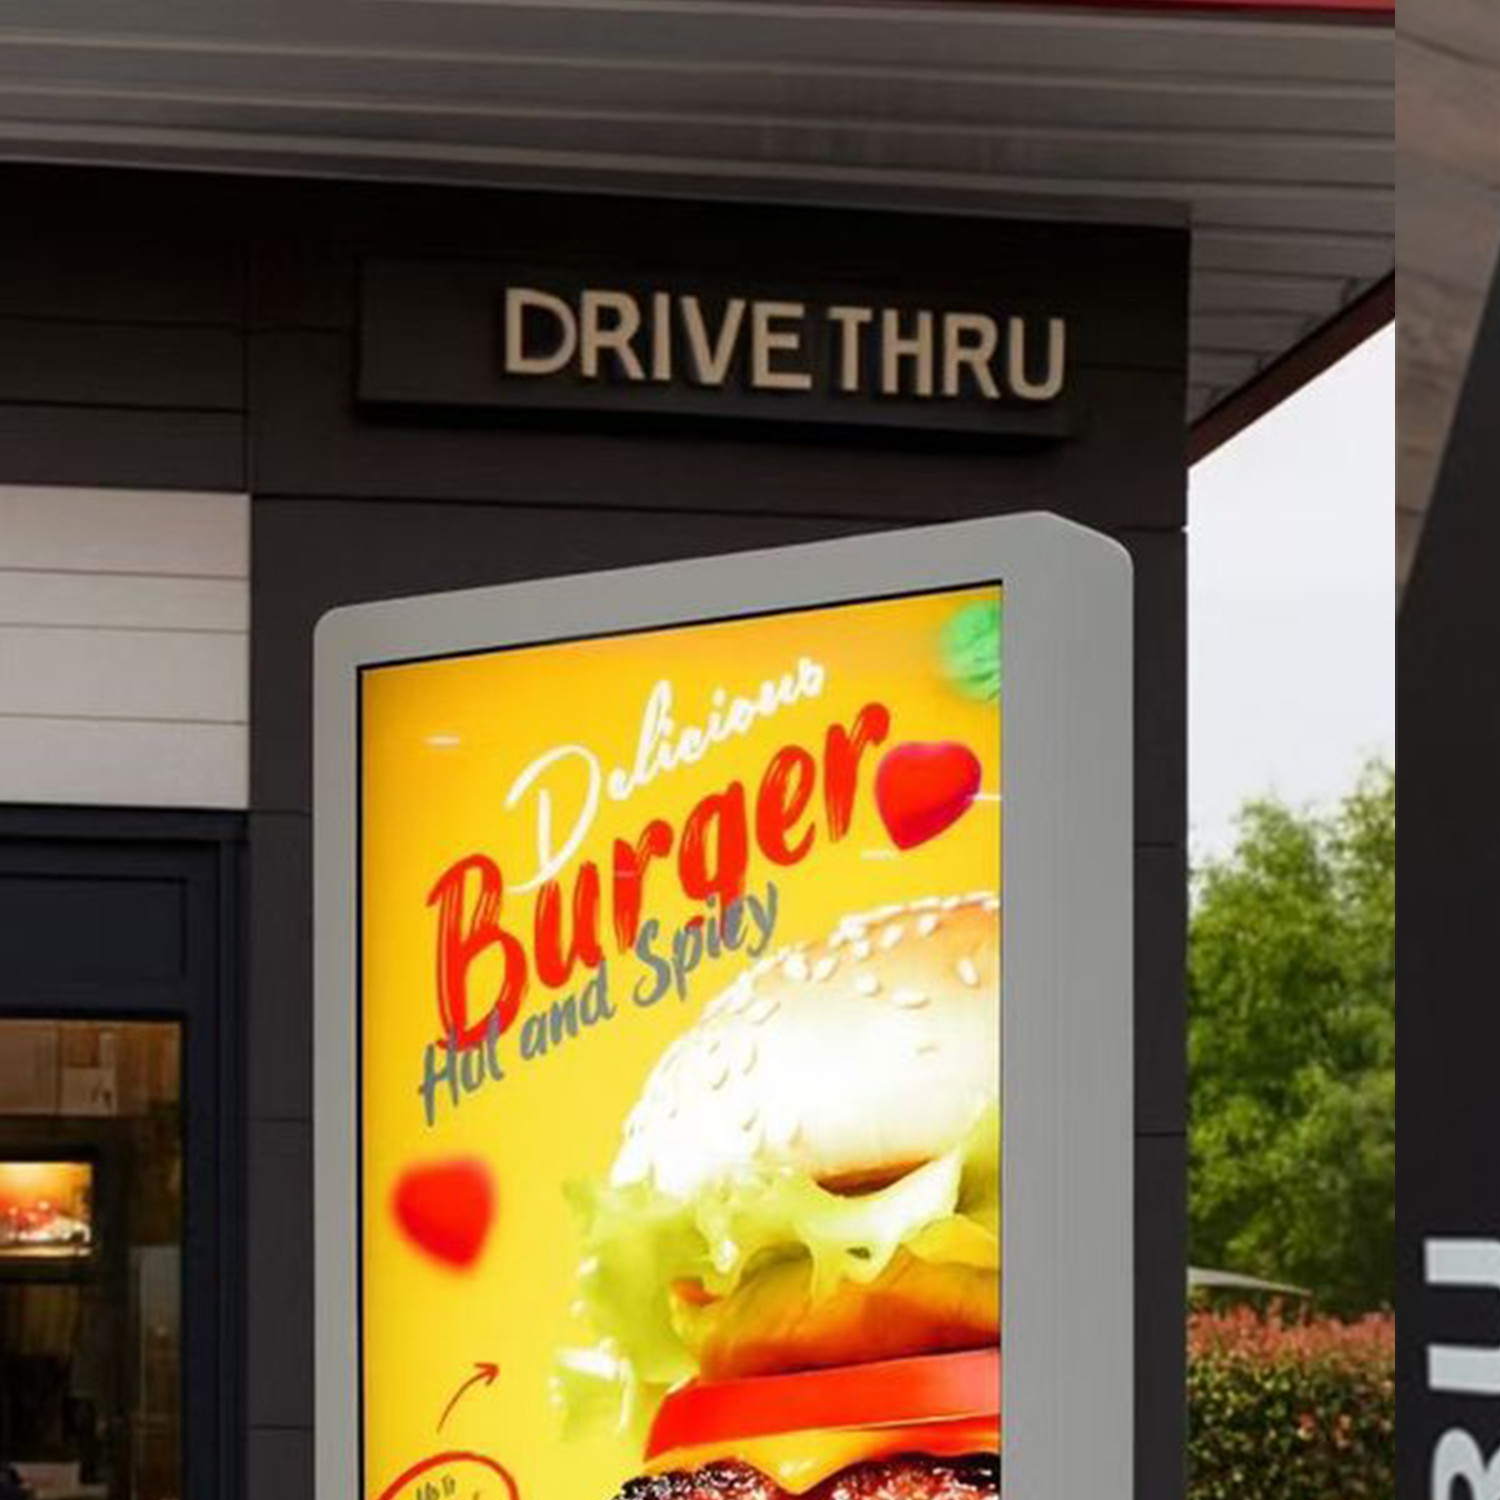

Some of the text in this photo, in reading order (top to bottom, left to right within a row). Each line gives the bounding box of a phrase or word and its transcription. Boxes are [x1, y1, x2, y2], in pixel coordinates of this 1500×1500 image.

[504, 287, 1066, 401] DRIVE THRU
[426, 702, 890, 1051] Burger
[504, 657, 825, 895] Delicious
[418, 880, 779, 1128] Hot and Spicy
